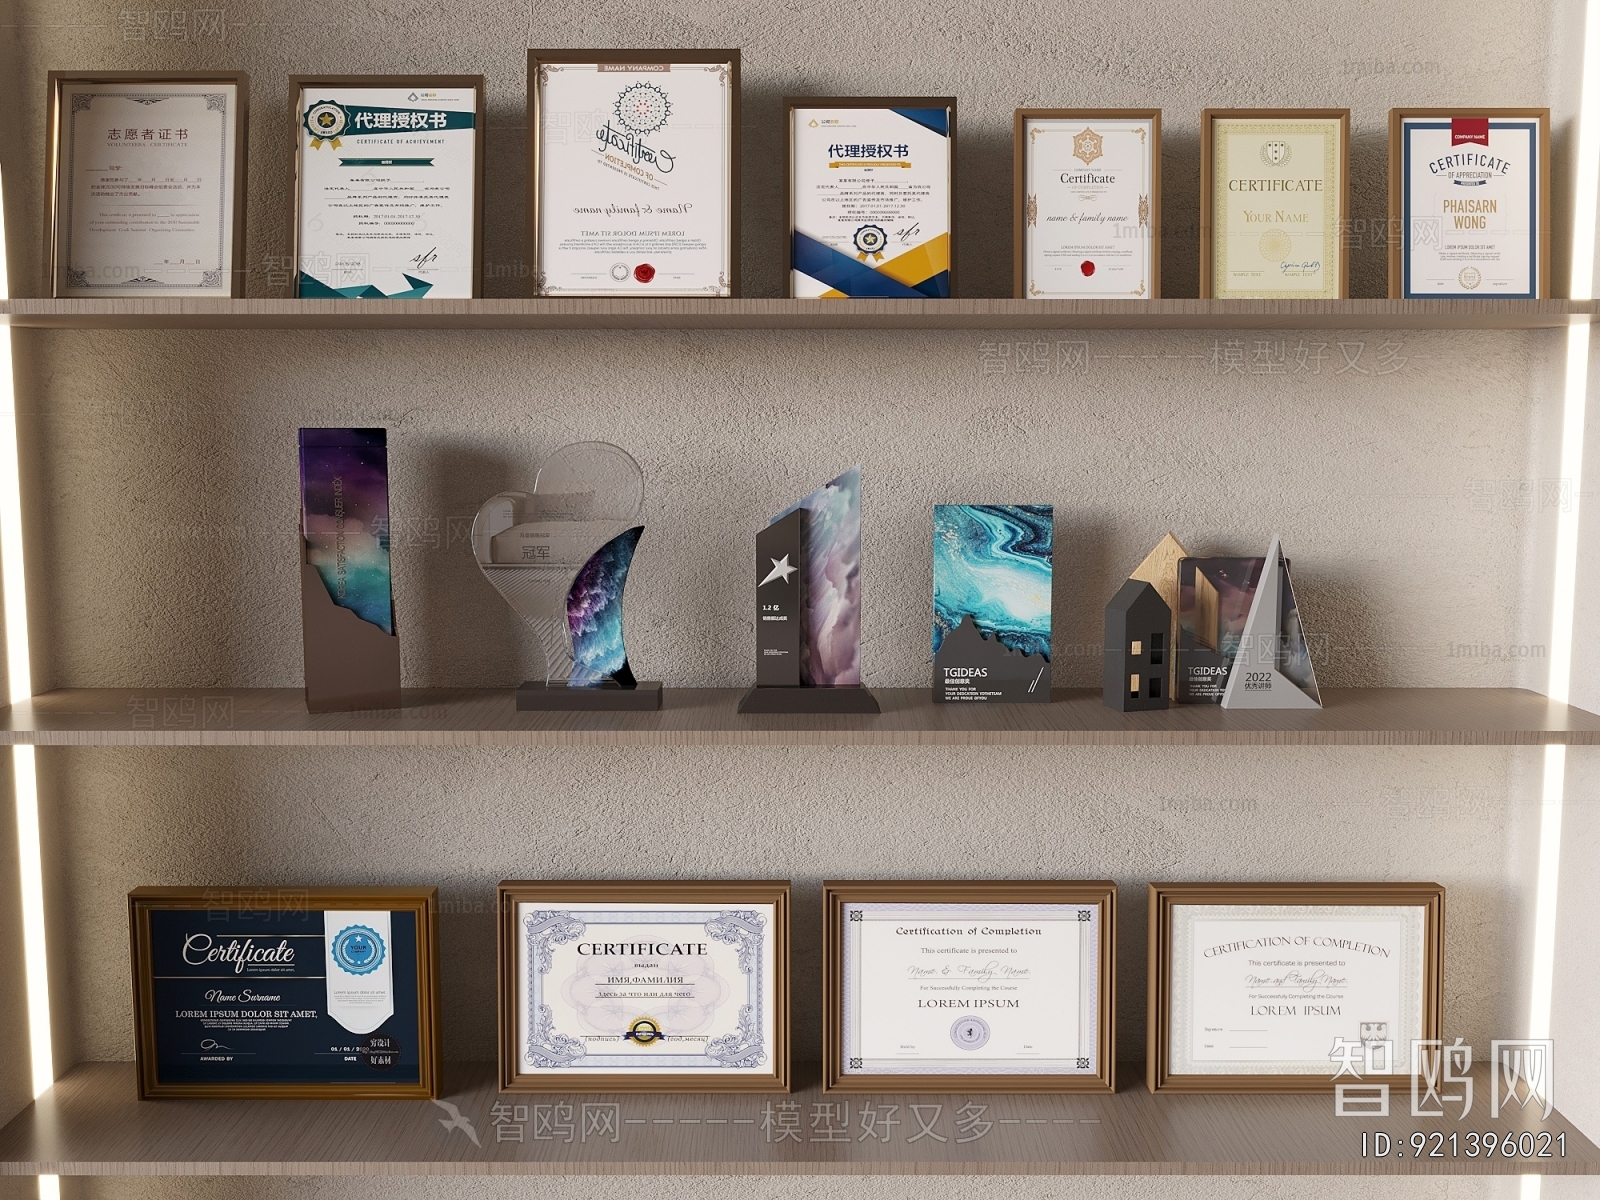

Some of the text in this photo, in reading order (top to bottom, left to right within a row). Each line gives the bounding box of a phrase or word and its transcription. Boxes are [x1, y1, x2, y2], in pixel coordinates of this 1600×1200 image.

[354, 112, 447, 129] 代理授权书
[107, 128, 188, 140] 志愿者证书
[828, 144, 909, 158] 代理授权书
[1429, 153, 1511, 175] CERTIFICATE
[1060, 172, 1116, 184] Certificate
[1448, 171, 1492, 179] OF APPRECIATION
[1228, 179, 1323, 192] CERTIFICATE
[1443, 199, 1497, 213] PHAISARN
[1078, 212, 1106, 225] family
[1453, 215, 1486, 229] WONG
[336, 531, 346, 575] SATISFACTION
[522, 545, 551, 560] 冠军
[943, 667, 988, 677] TGIDEAS
[1187, 666, 1228, 676] TGIDEAS
[1245, 672, 1272, 682] 2022
[1244, 682, 1272, 690] 优秀讲师
[895, 927, 1042, 936] Certification of Completion
[577, 942, 708, 956] CERTIFICATE
[977, 947, 1009, 955] presented
[1203, 936, 1391, 958] CERTIFICATION OF COMPLETION
[182, 933, 295, 974] Certificate
[1304, 960, 1338, 968] presented
[607, 976, 684, 985] ИМЯ,ФАМИЛИЯ
[204, 989, 281, 1004] Name Surname
[918, 999, 1020, 1008] LOREM IPSUM
[175, 1010, 318, 1019] LOREM IPSUM DOLOR SIT AMET,
[1250, 1005, 1341, 1016] LOREM IPSUM
